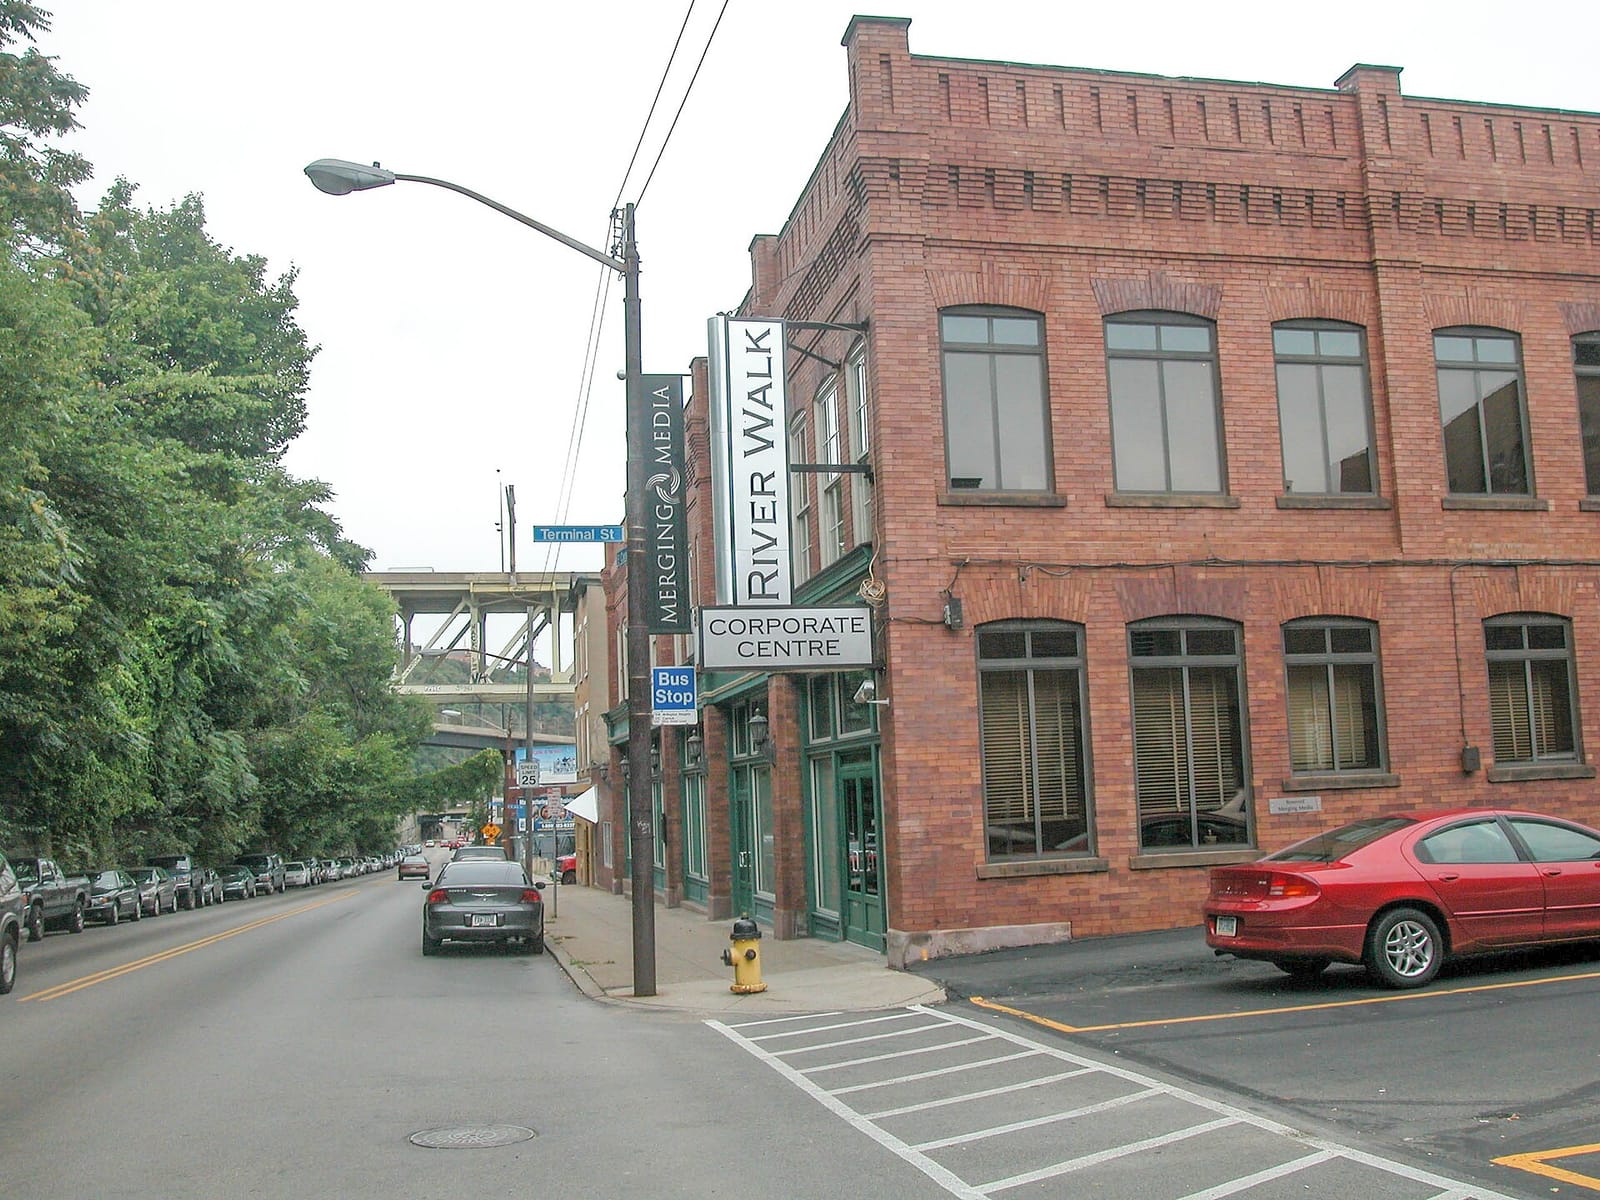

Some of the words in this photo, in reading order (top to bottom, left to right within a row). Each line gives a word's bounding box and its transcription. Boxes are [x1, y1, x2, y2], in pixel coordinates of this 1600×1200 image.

[742, 327, 776, 459] WALK
[651, 384, 672, 466] MEDIA
[540, 528, 595, 540] Terminal
[600, 528, 614, 540] St
[747, 470, 780, 601] RIVER
[653, 502, 679, 625] MERGING
[708, 616, 866, 636] CORPORATE
[736, 639, 841, 658] CENTRE
[658, 671, 689, 686] Bus
[655, 688, 693, 706] Stop
[521, 775, 537, 786] 25
